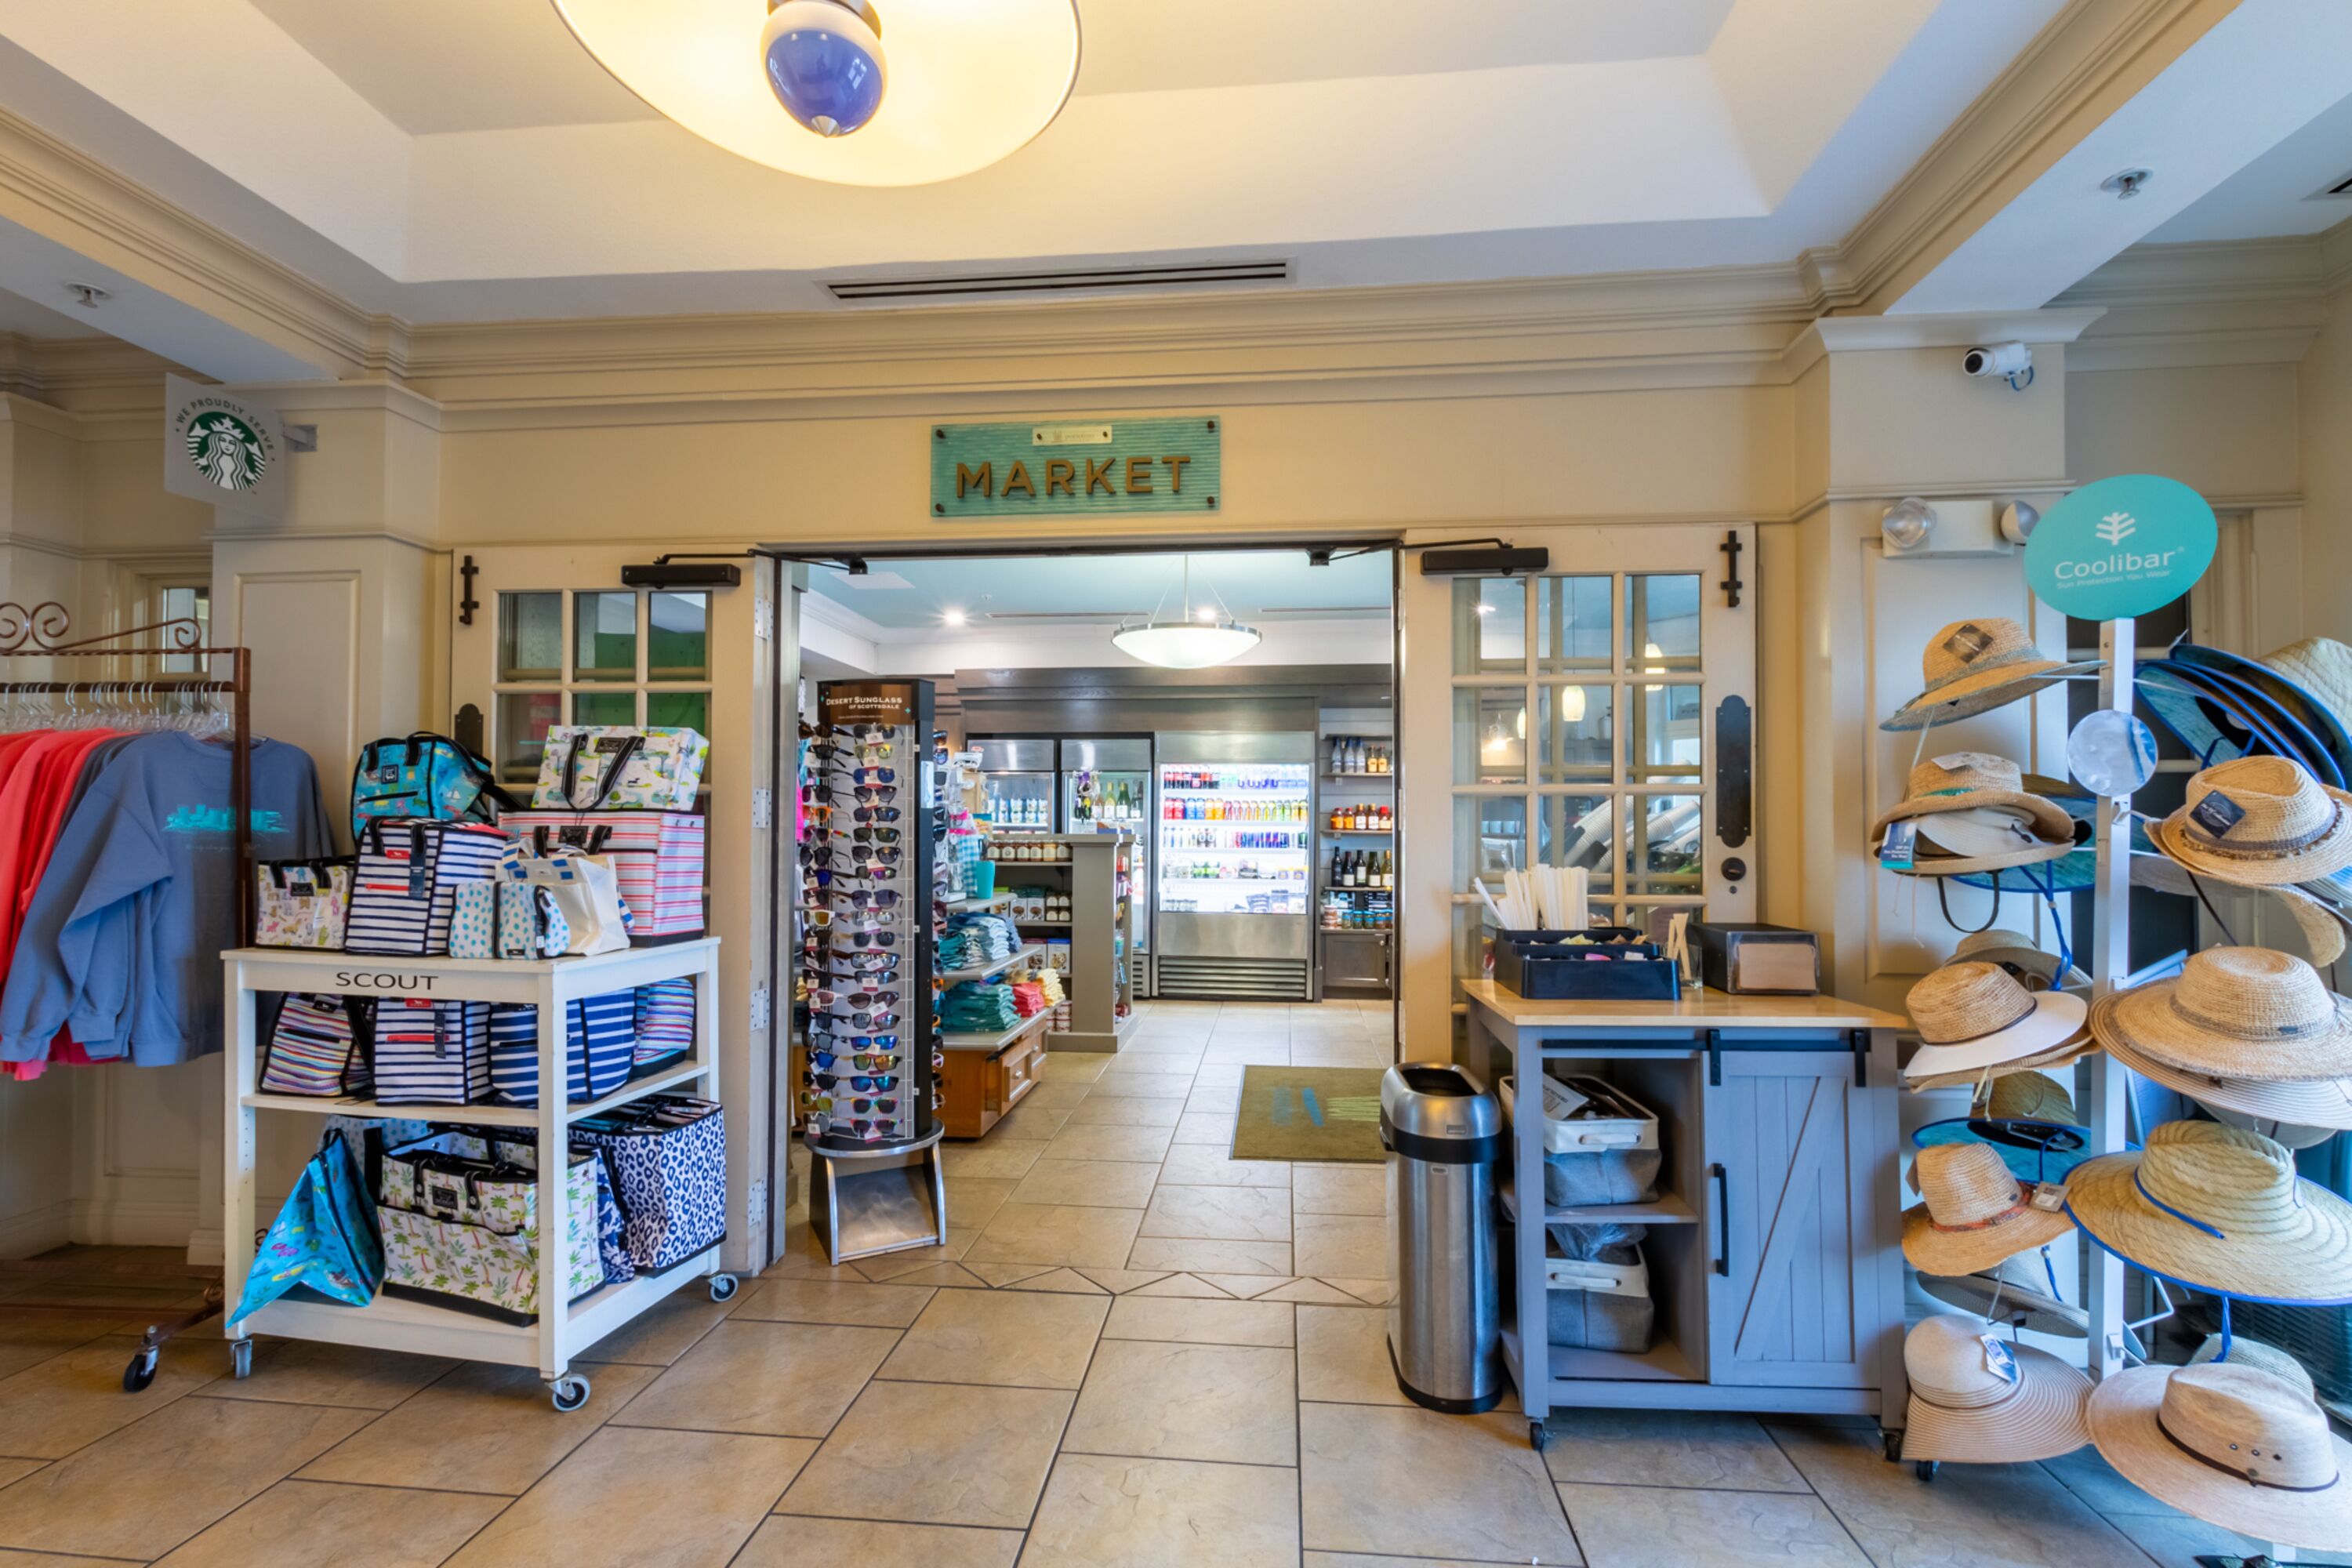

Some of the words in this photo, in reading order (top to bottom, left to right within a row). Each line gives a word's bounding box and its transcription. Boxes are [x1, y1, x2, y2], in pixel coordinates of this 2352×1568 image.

[176, 408, 190, 424] WE
[191, 397, 245, 415] PROUDLY
[248, 416, 274, 451] SERVE
[956, 456, 1191, 499] MARKET
[2054, 550, 2176, 579] Coolibar
[2056, 580, 2074, 590] Sun
[2077, 575, 2124, 586] Protection
[2126, 572, 2143, 581] You
[2146, 570, 2171, 579] Wear
[335, 971, 439, 991] SCOUT
